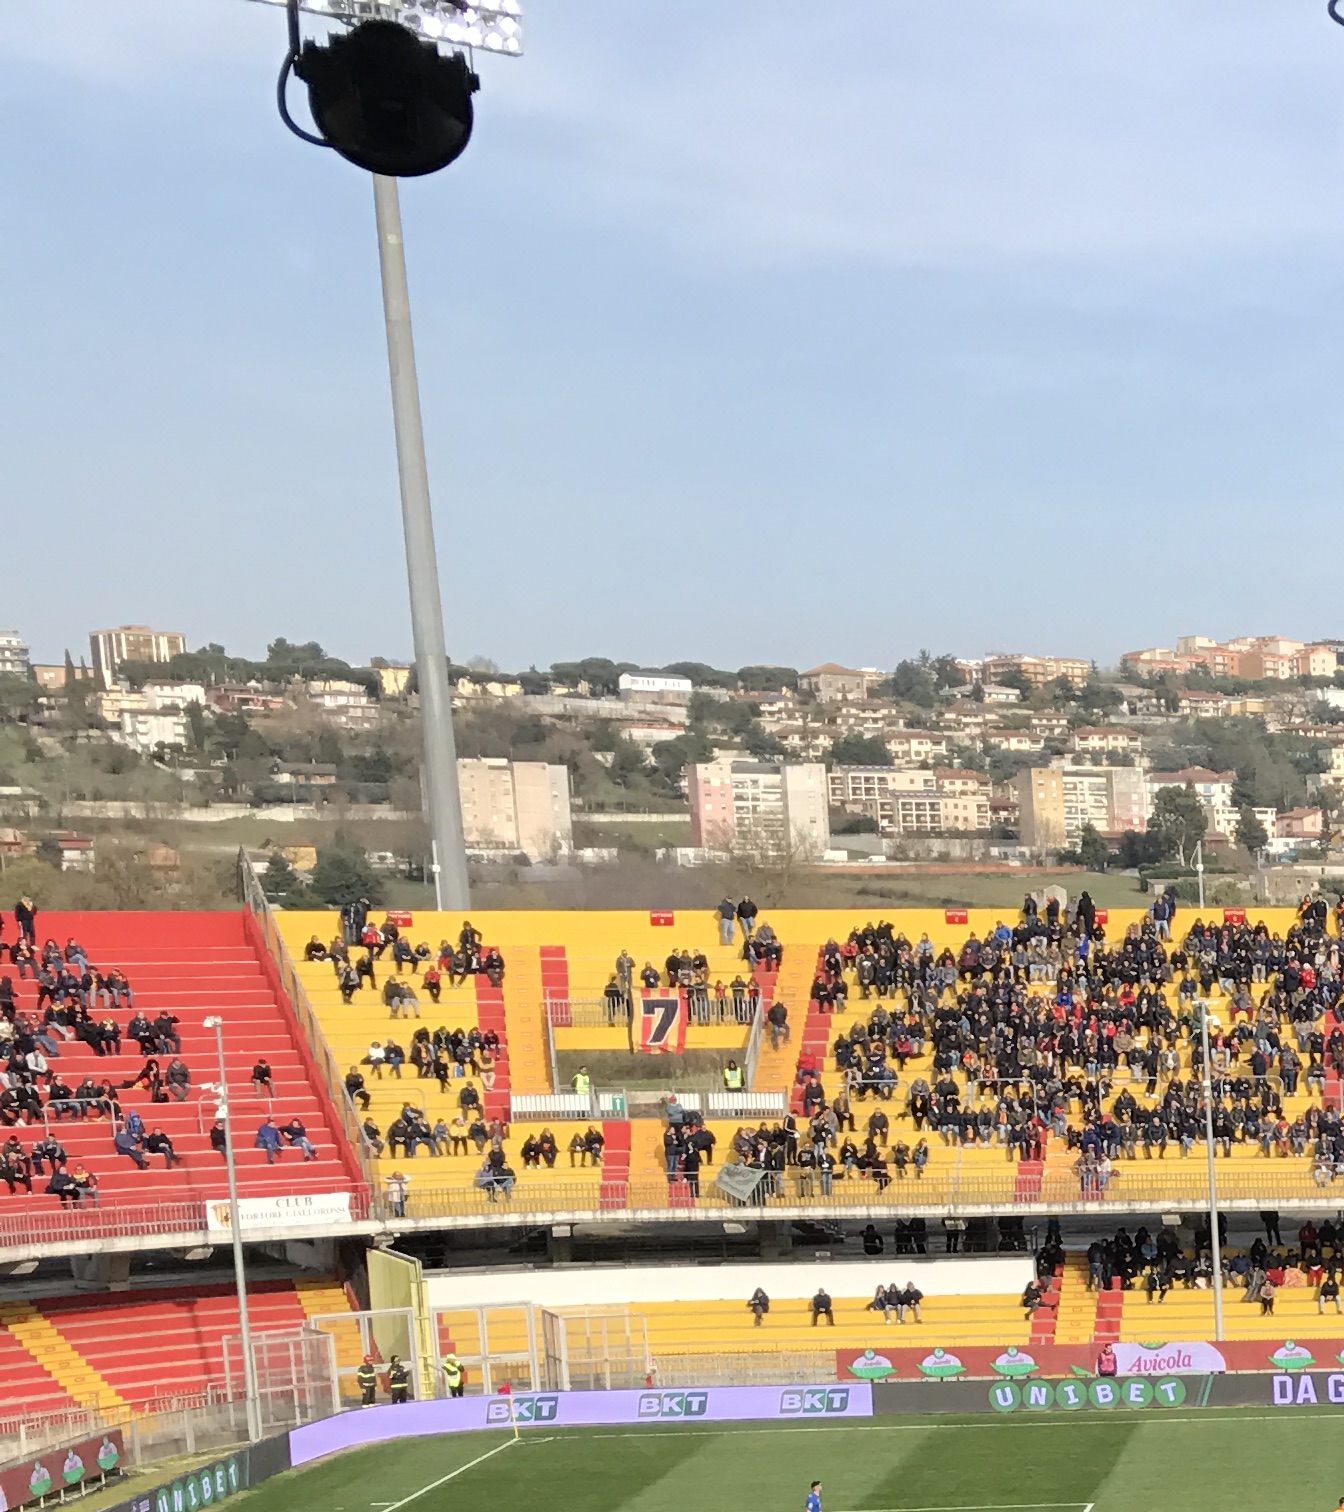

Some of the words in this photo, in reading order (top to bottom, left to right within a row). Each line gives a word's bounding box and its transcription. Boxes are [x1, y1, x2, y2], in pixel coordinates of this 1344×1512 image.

[642, 997, 680, 1045] 7
[275, 1197, 313, 1208] CLUB
[1128, 1350, 1193, 1373] Avicola
[781, 1390, 849, 1412] BKT
[994, 1381, 1178, 1406] UNIBET
[1273, 1375, 1318, 1405] DA
[487, 1398, 557, 1422] BKT
[639, 1393, 707, 1416] BKT
